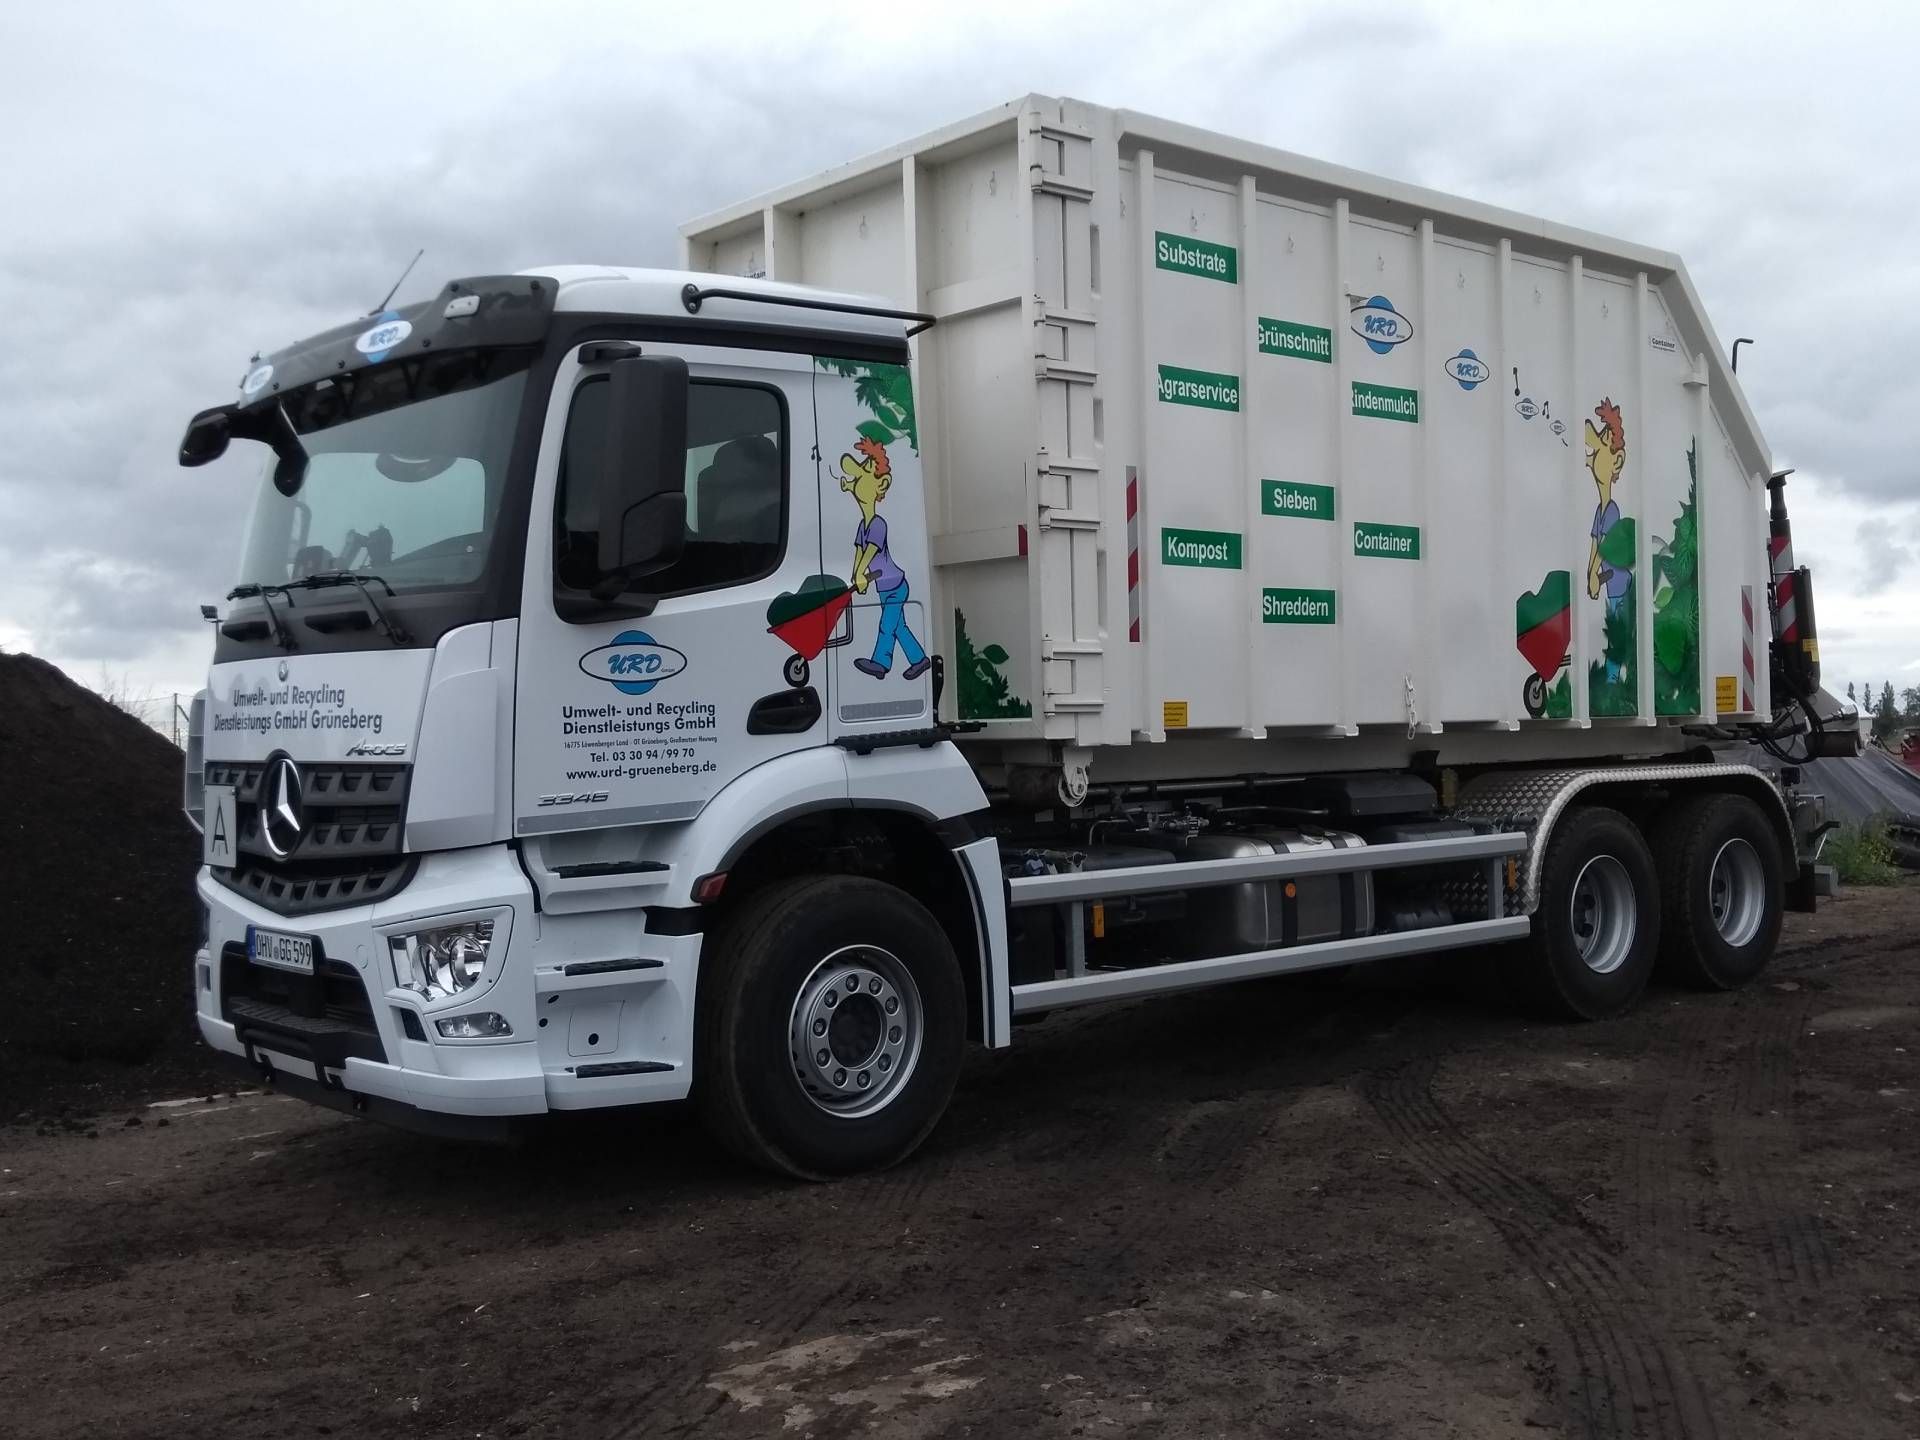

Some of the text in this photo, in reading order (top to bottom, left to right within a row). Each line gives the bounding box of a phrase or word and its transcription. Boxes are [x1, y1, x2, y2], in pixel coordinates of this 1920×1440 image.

[1158, 240, 1227, 274] Substrate
[1364, 315, 1398, 337] URD
[1456, 362, 1480, 378] URD
[1273, 487, 1318, 512] Sieben
[1167, 536, 1229, 564] Kompost
[1354, 529, 1413, 553] Container
[1262, 594, 1330, 617] Shreddern
[607, 653, 663, 675] URD
[233, 684, 346, 709] Umwelt- und Recycling
[213, 707, 383, 735] Dienstleistungs GmbH Grüneberg
[562, 701, 716, 719] Umwelt- und Recycling
[563, 716, 716, 735] Dienstleistungs GmbH
[590, 751, 609, 763] Tel.
[612, 751, 626, 762] 03
[629, 750, 643, 761] 30
[682, 747, 695, 758] 70
[566, 760, 717, 780] www.urd-grueneberg.de
[537, 790, 610, 807] 3346
[211, 796, 229, 855] A
[256, 933, 312, 966] OHV GG 599
